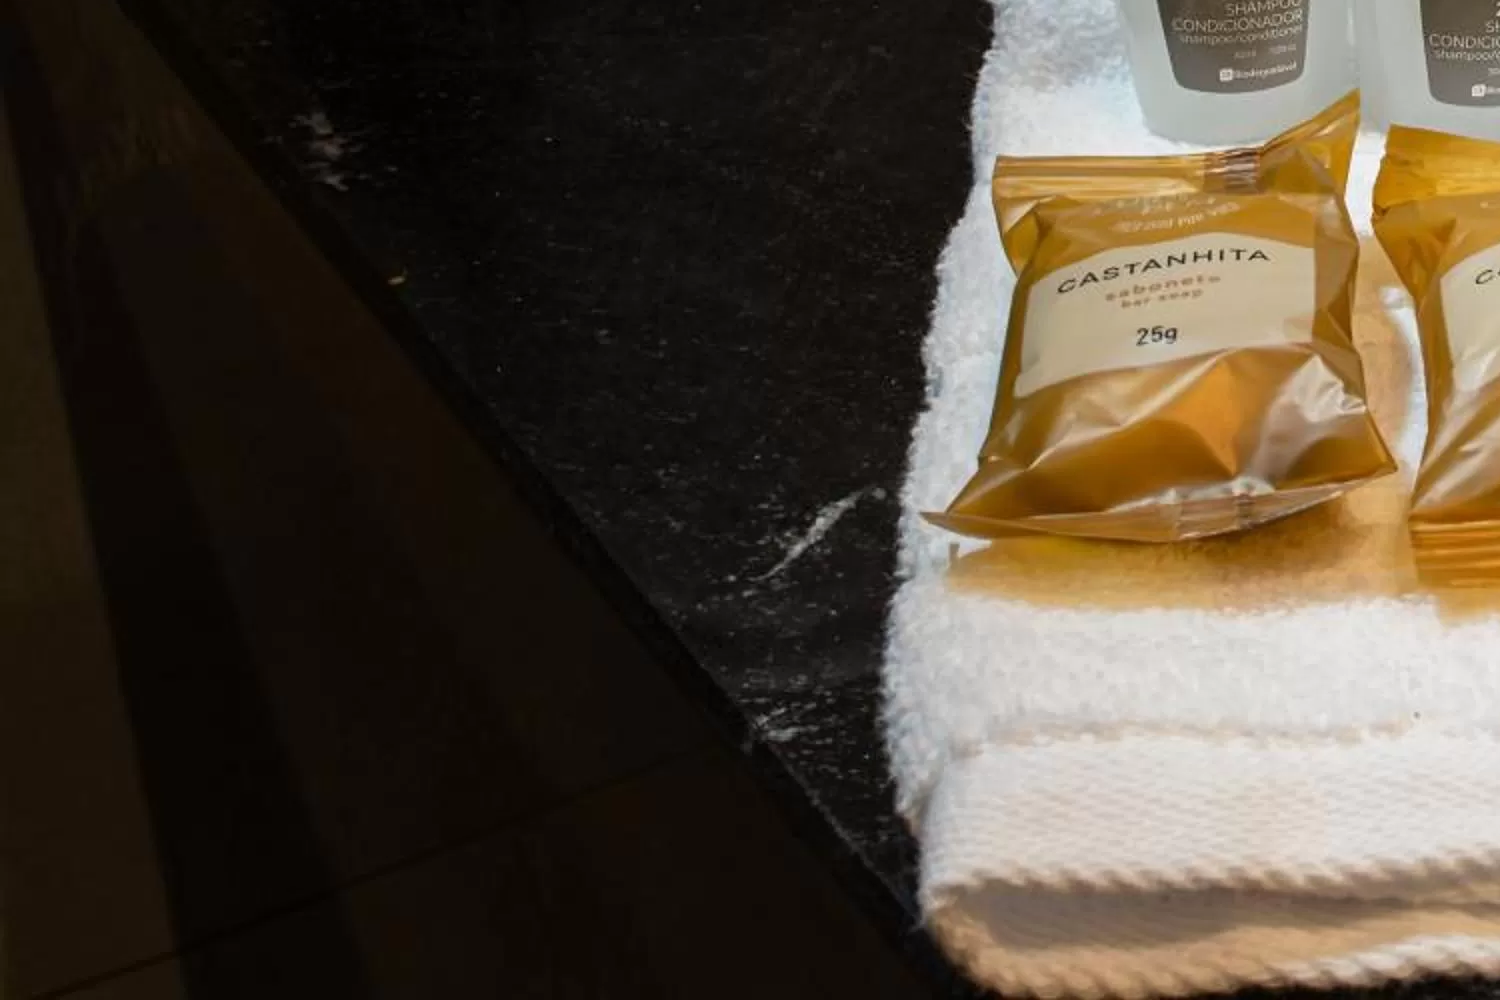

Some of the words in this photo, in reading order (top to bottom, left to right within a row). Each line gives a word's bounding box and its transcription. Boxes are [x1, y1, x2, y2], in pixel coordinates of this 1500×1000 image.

[1171, 8, 1303, 33] CONDICIONADOR
[1056, 247, 1272, 295] CASTANHITA
[1135, 325, 1178, 347] 25g
